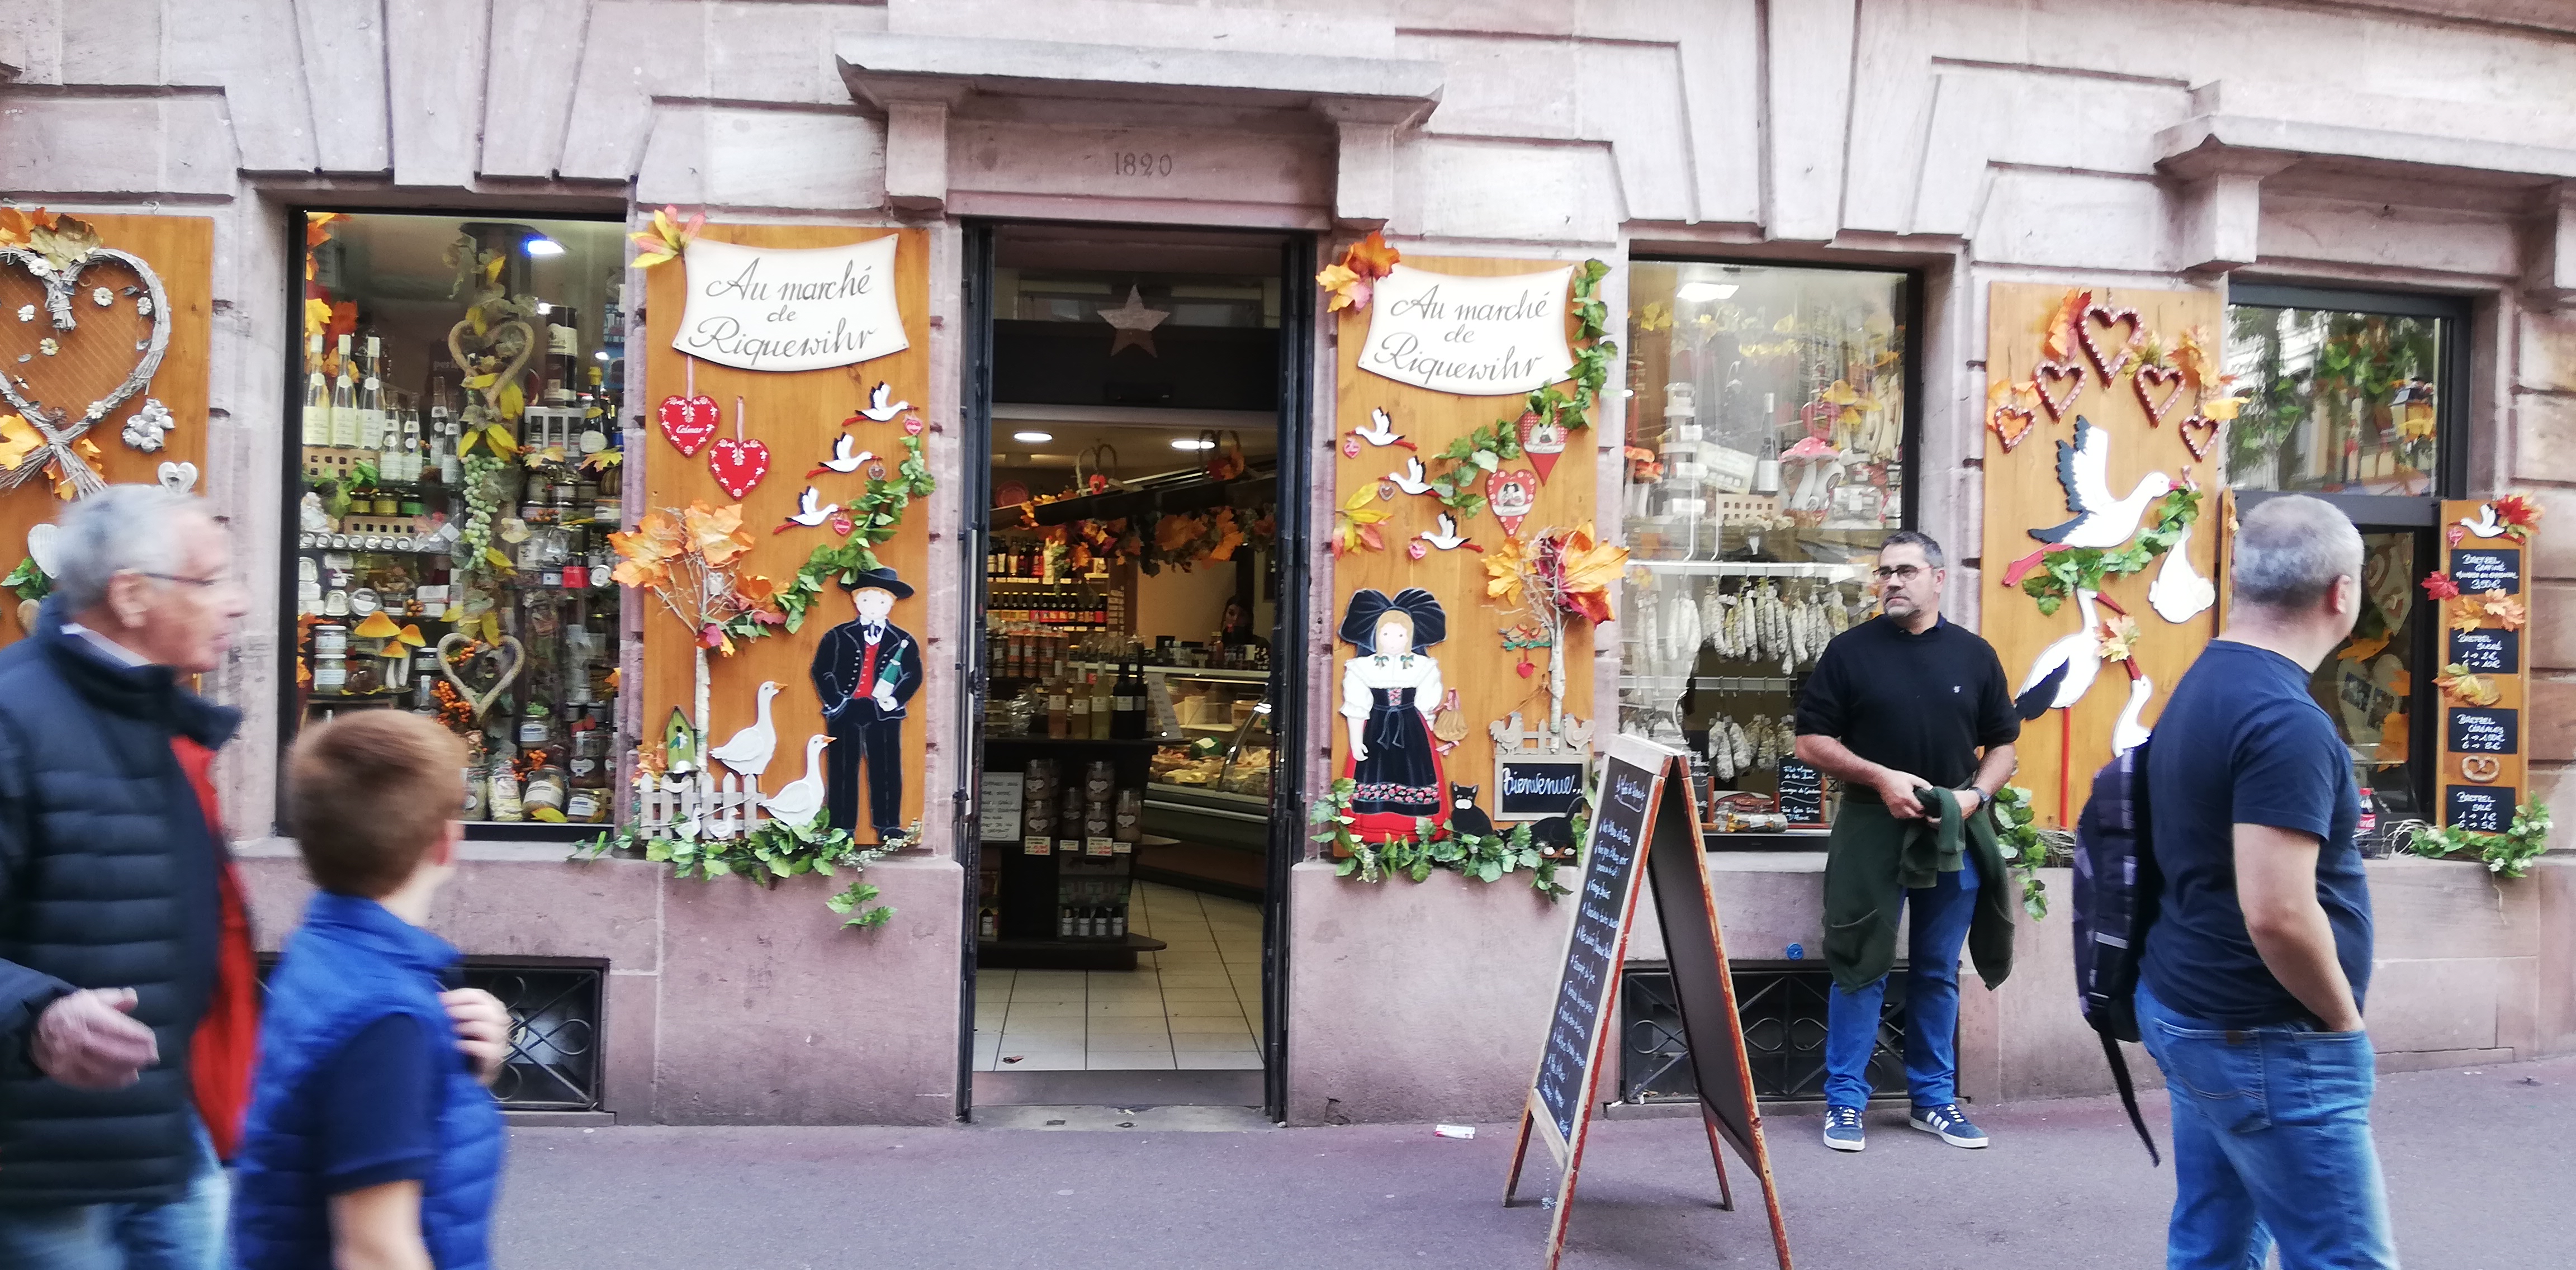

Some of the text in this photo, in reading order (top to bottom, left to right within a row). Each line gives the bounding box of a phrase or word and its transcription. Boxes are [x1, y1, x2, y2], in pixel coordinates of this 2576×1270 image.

[1114, 151, 1172, 177] 1820
[705, 257, 873, 301] Au marché
[766, 304, 797, 323] de
[1390, 284, 1551, 321] Au marché
[688, 316, 878, 366] Riquewihr
[1444, 323, 1475, 343] de
[1374, 332, 1545, 385] Riquewihr
[676, 424, 704, 433] Colmar
